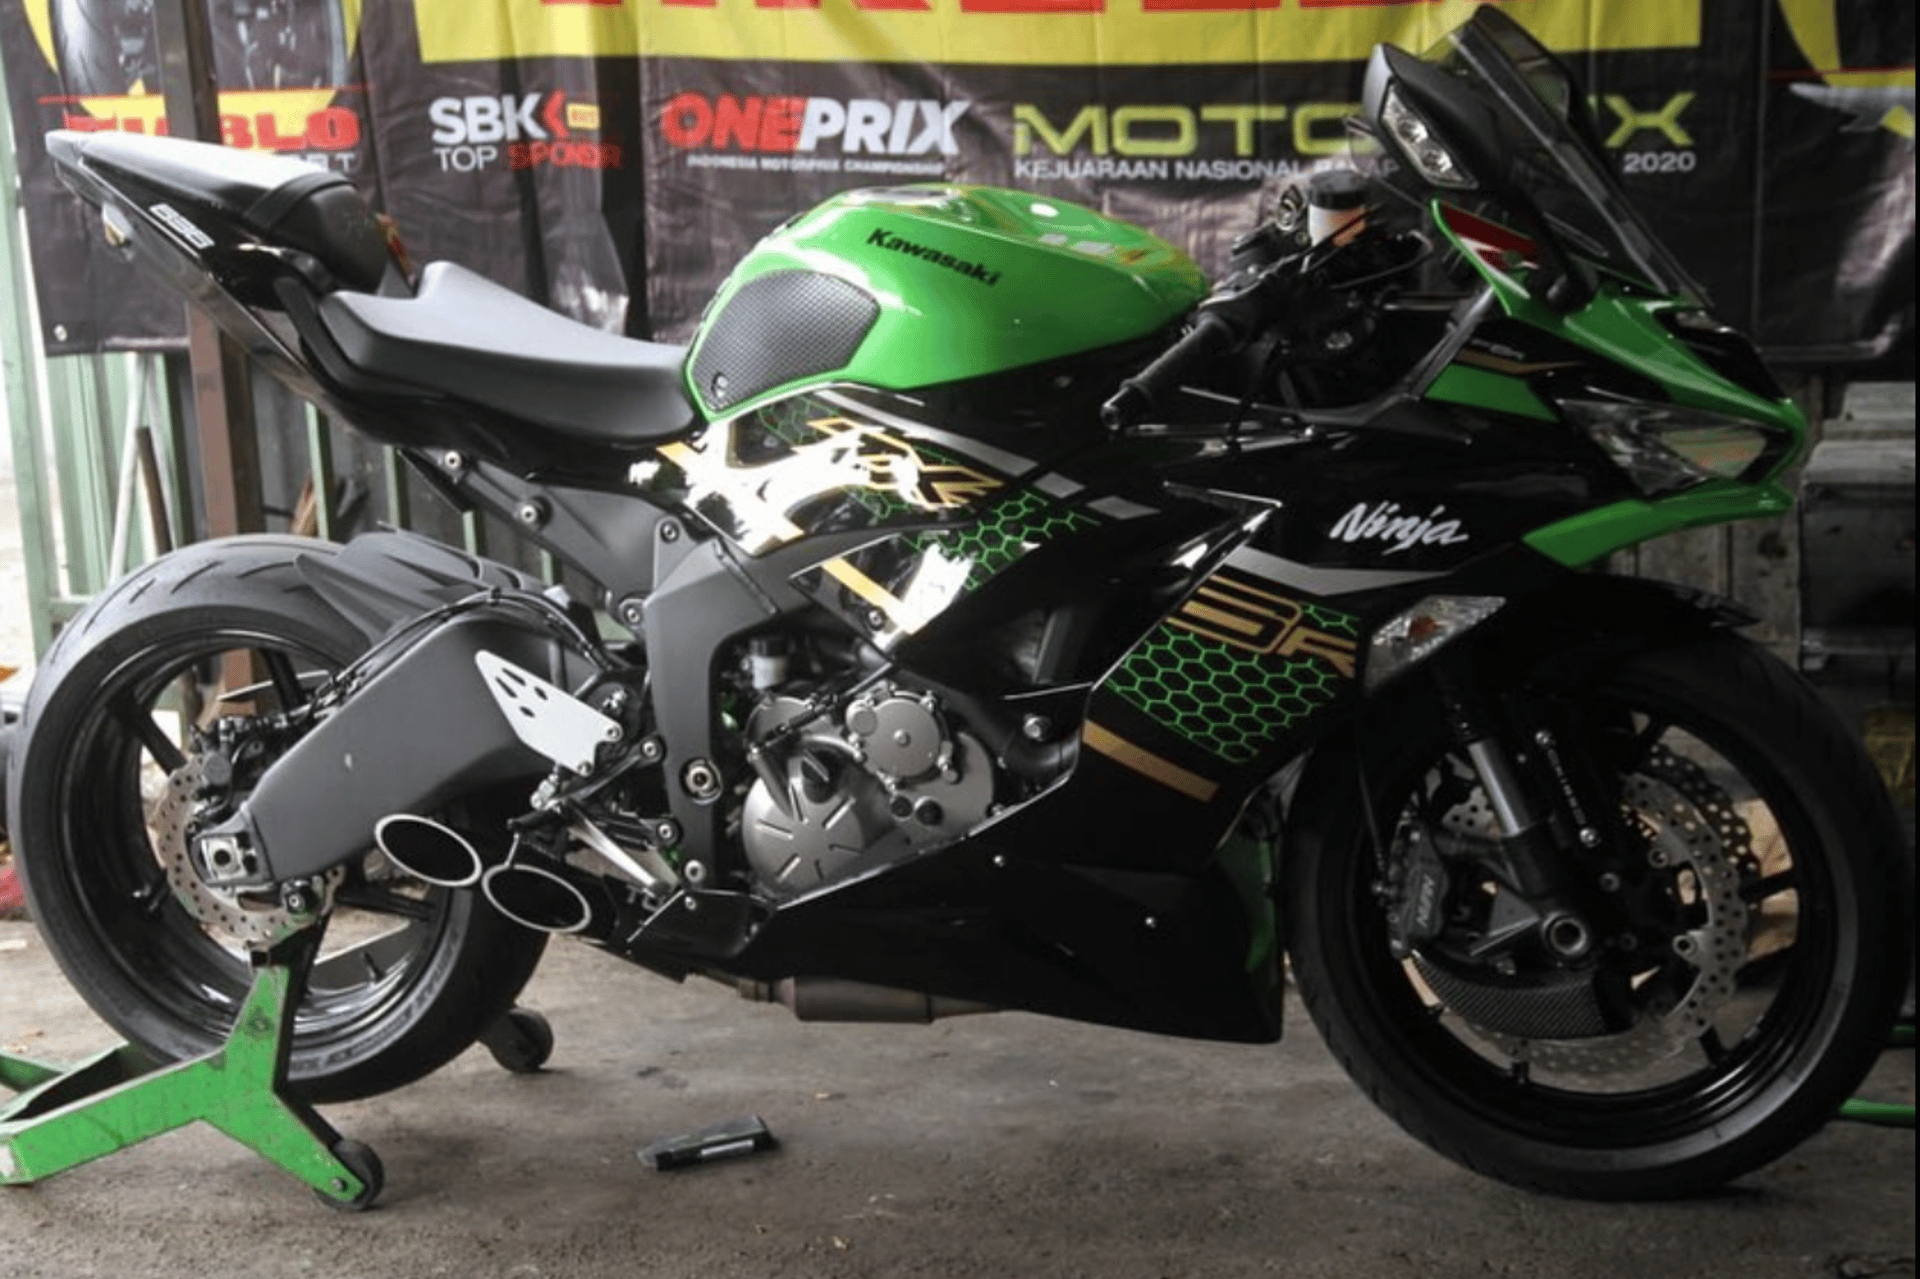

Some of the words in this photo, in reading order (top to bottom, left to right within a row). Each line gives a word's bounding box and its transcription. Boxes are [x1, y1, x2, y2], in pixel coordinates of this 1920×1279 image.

[429, 92, 546, 145] SBK
[661, 91, 971, 155] ONEPRIX
[433, 145, 498, 172] TOP
[1014, 159, 1168, 181] KEJUARAAN
[1176, 160, 1301, 181] NASIONAL
[1623, 151, 1696, 174] 2020
[866, 227, 1002, 286] Kawasaki
[1329, 500, 1469, 556] Ninja
